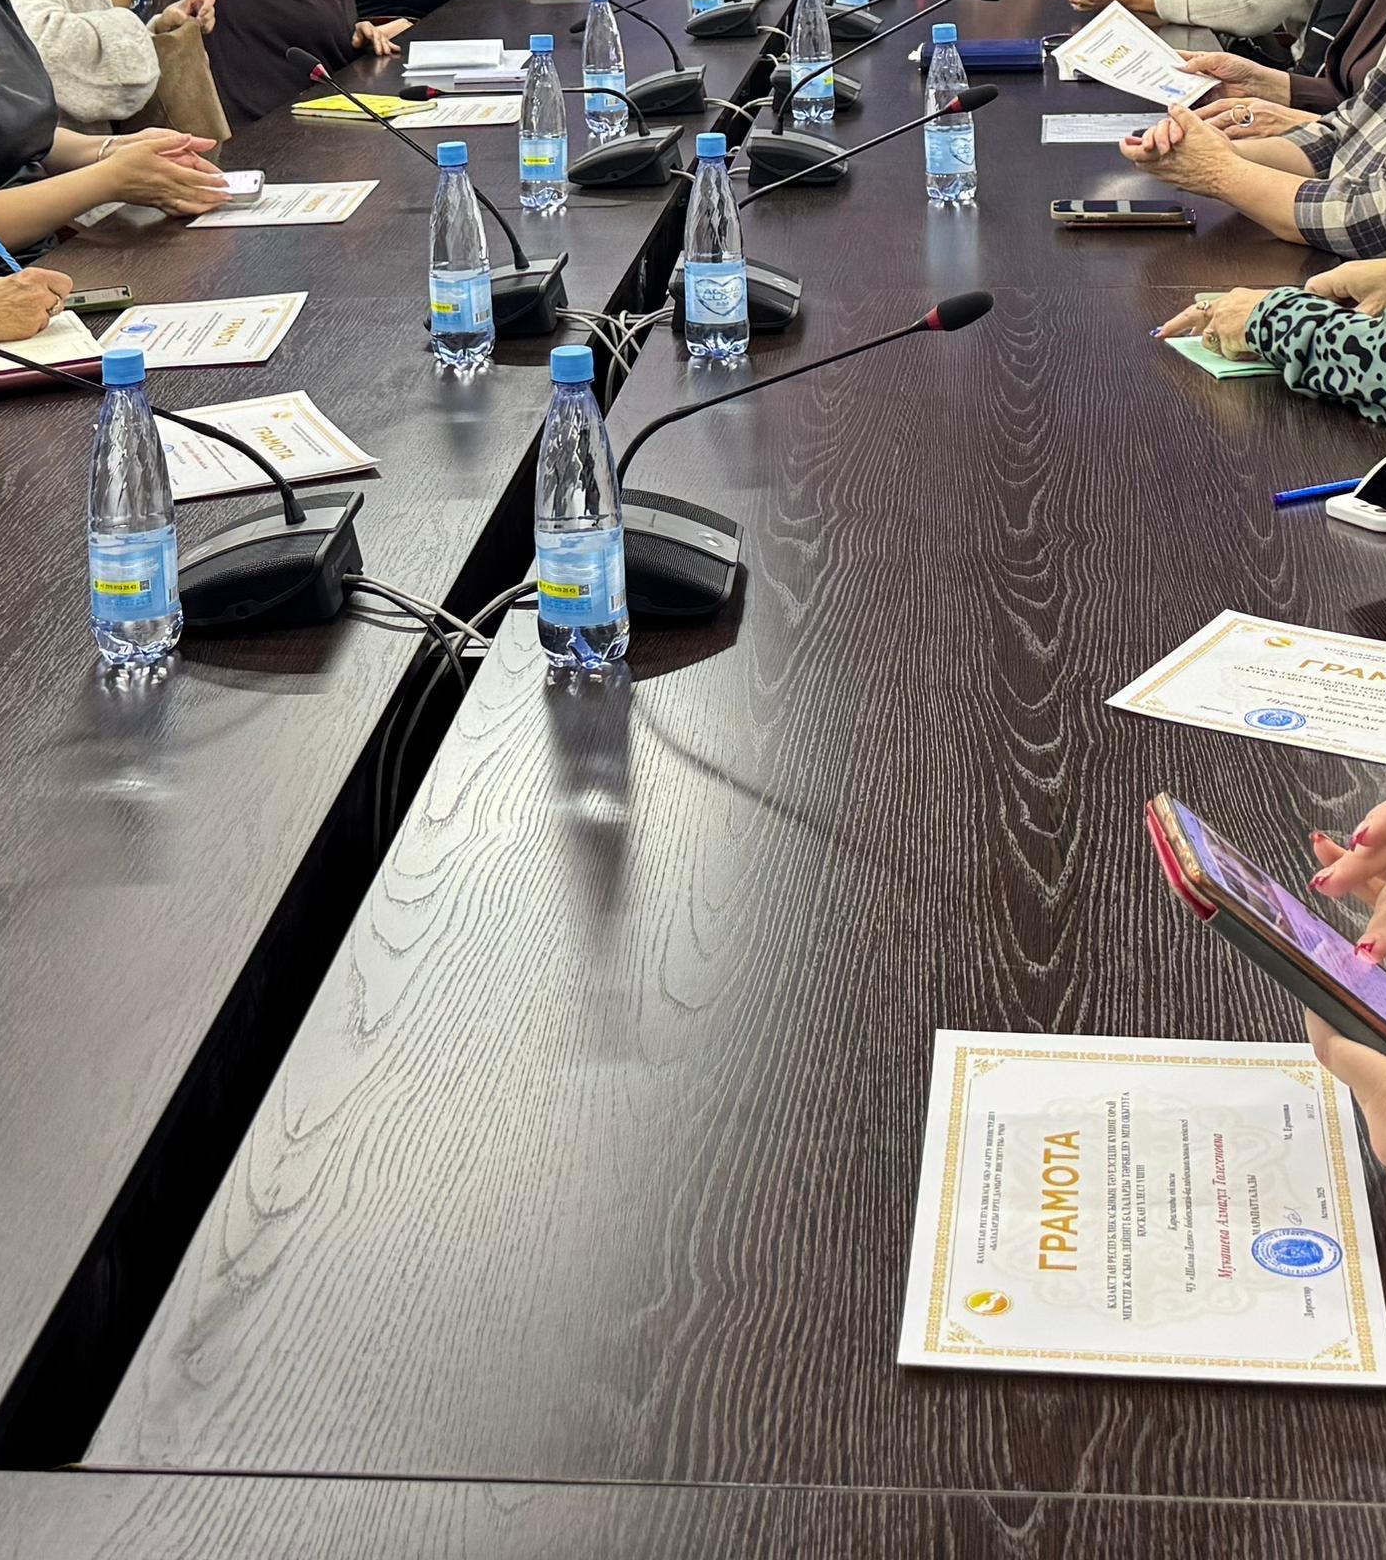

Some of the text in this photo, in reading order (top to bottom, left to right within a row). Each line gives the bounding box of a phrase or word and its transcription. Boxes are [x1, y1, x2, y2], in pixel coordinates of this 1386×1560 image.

[252, 426, 296, 461] ГРАМОТА
[1037, 1128, 1082, 1274] ГРАМОТА
[1217, 1230, 1236, 1280] Мукашева
